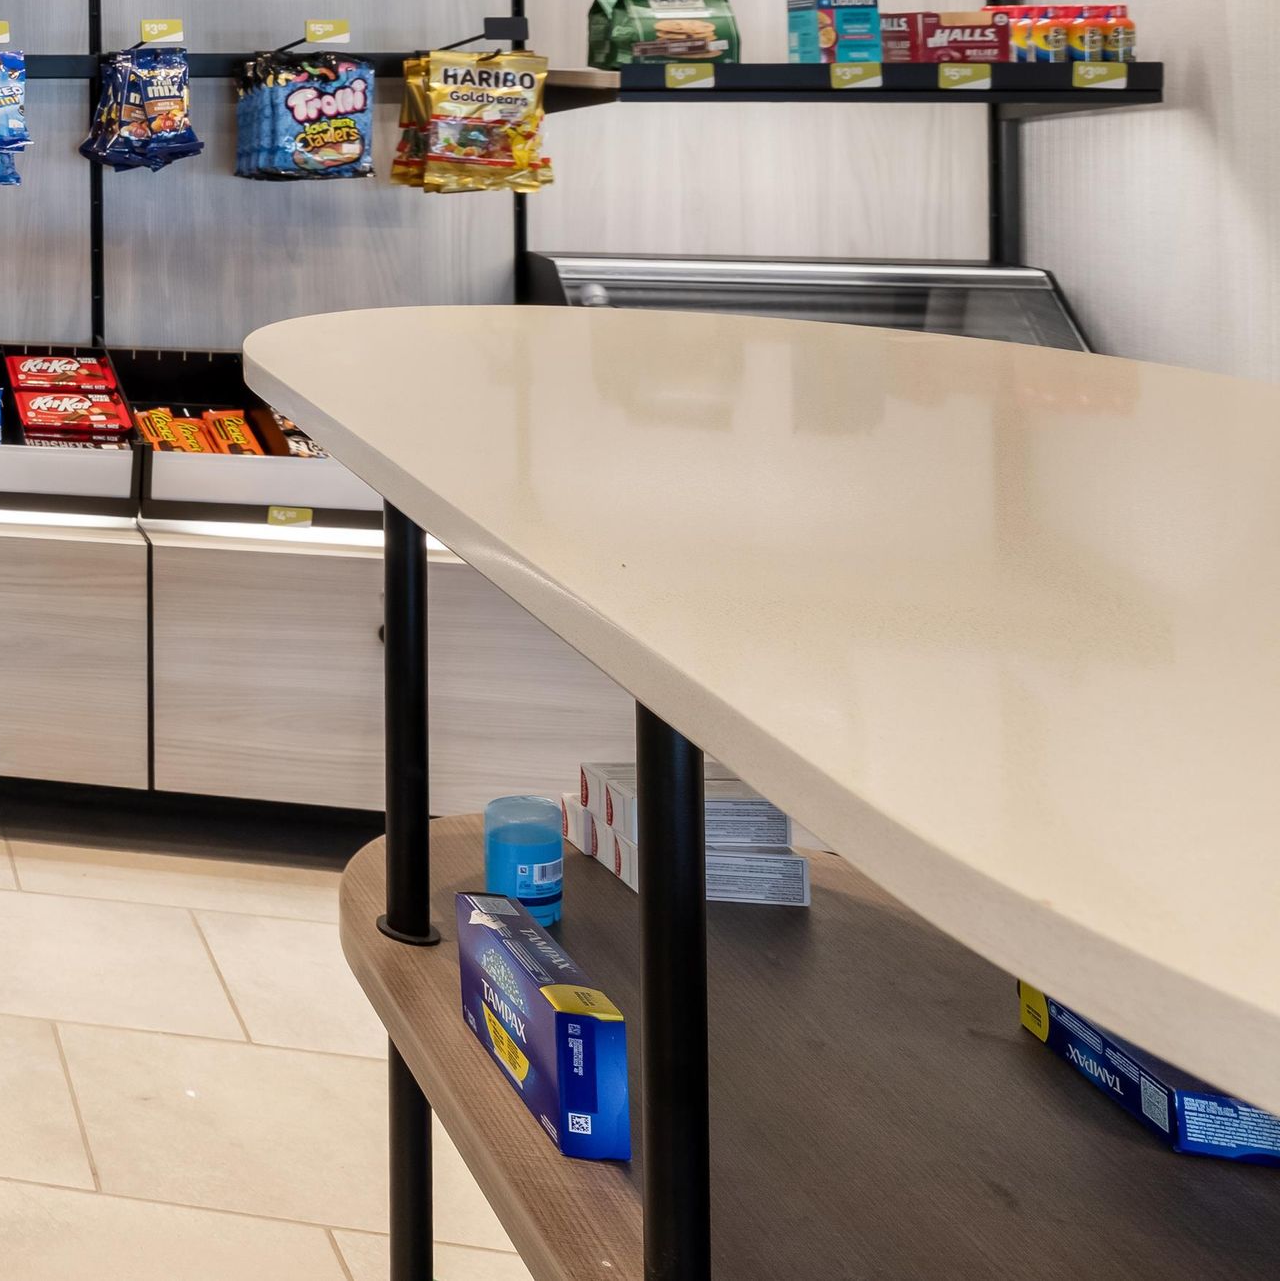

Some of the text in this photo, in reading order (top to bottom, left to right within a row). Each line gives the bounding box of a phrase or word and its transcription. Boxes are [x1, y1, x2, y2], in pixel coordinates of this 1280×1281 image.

[148, 84, 180, 98] mix
[443, 68, 535, 90] HARIBO
[287, 79, 367, 120] Trolli
[450, 91, 529, 106] Goldbears
[295, 127, 359, 151] Crawlers
[520, 927, 577, 974] TAMPAX
[482, 977, 528, 1044] TAMPAX
[1067, 1043, 1124, 1096] TAMPAX
